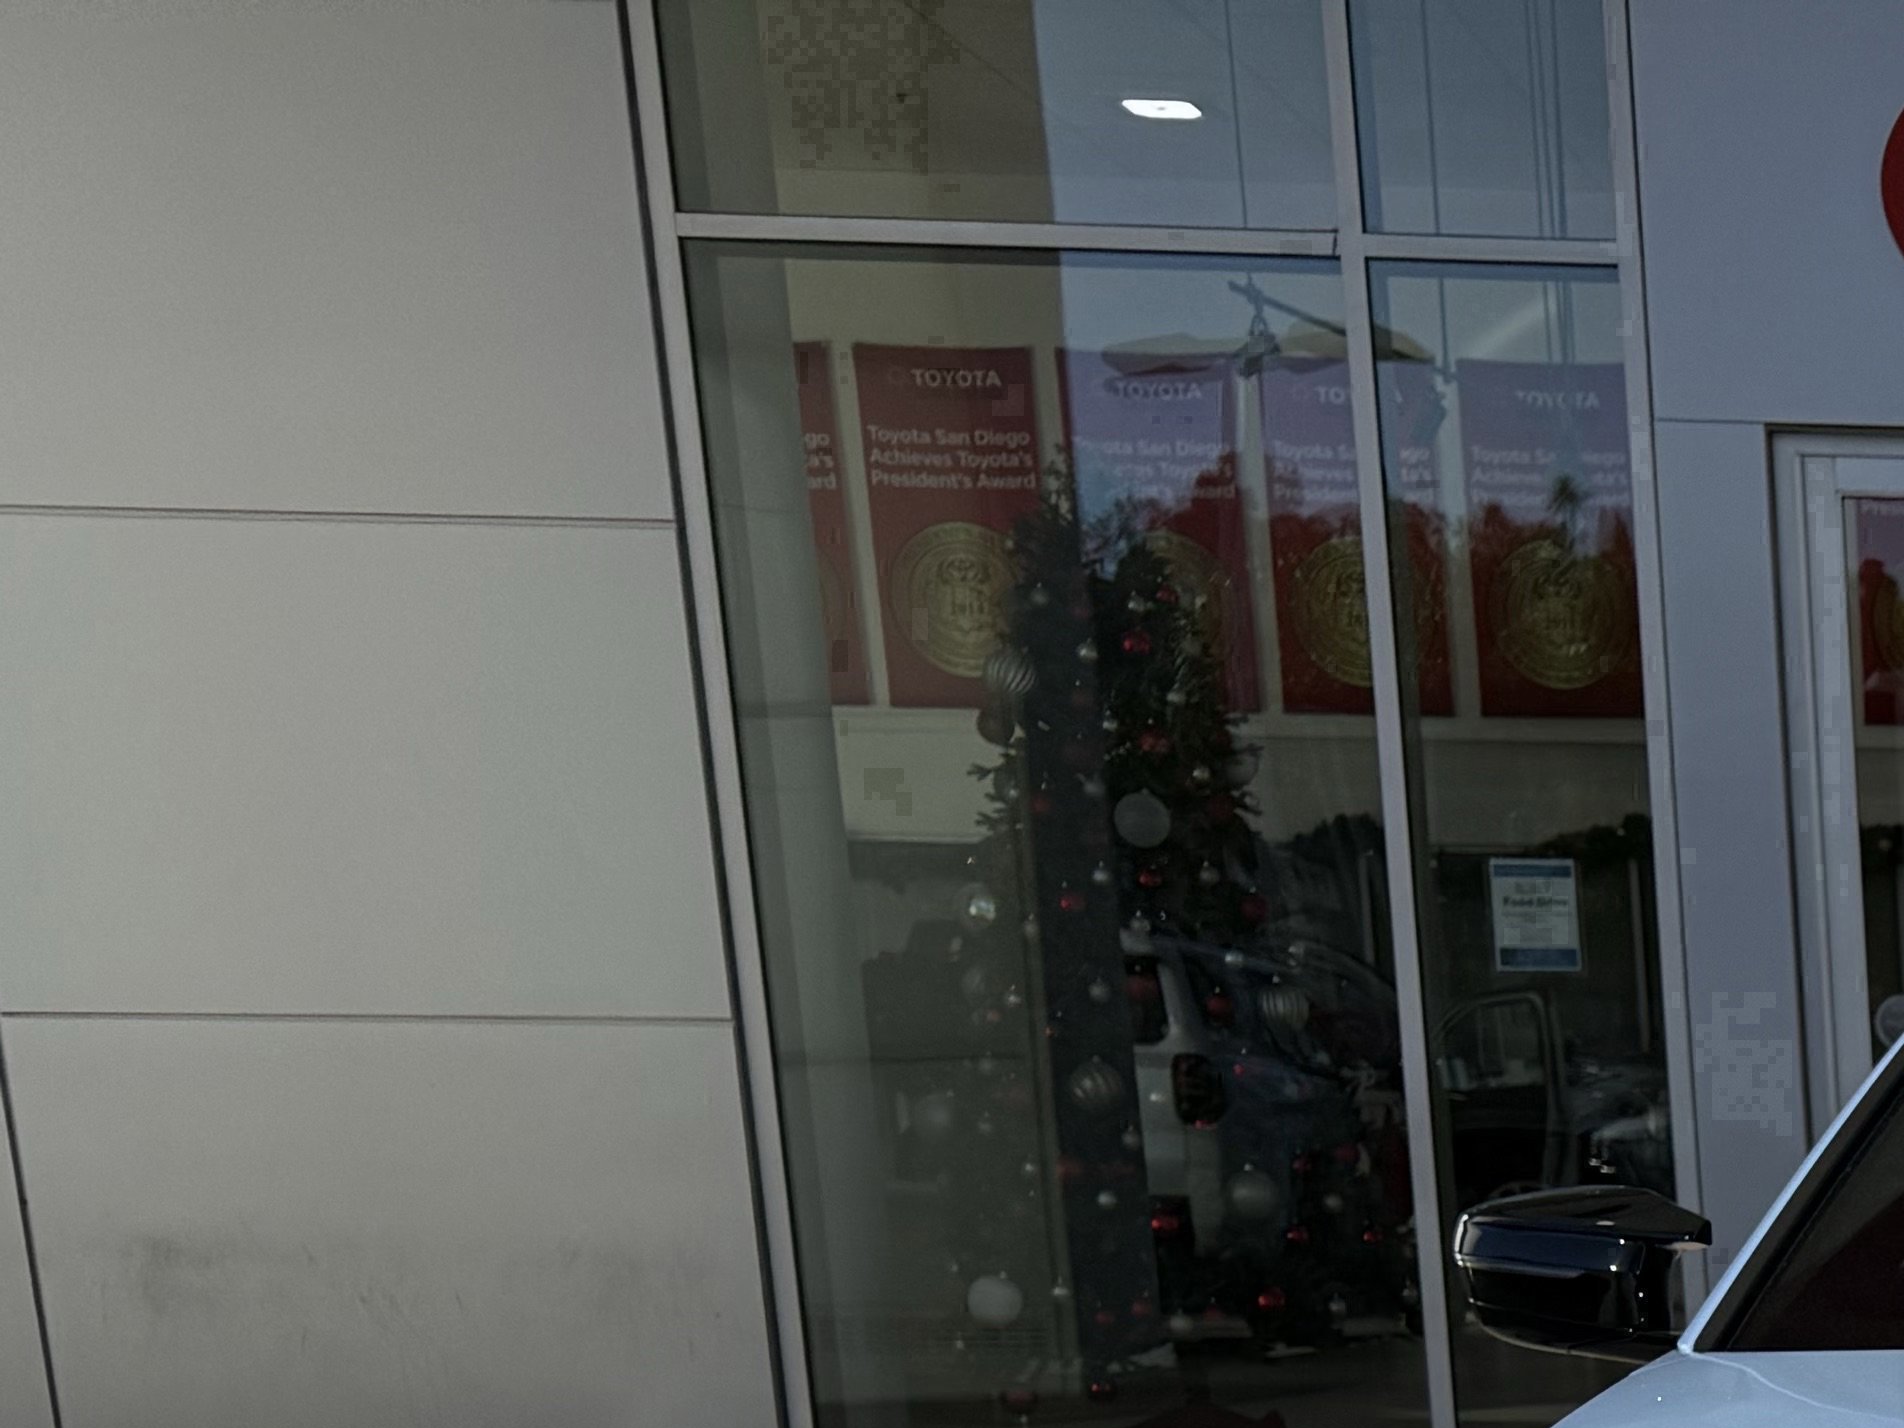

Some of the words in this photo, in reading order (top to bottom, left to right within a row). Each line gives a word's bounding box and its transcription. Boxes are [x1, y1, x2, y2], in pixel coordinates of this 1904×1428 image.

[910, 368, 1003, 388] TOYOTA
[1114, 381, 1203, 401] TOYOTA
[867, 425, 931, 446] Toyota
[935, 429, 970, 446] San
[974, 429, 1031, 448] Diego
[870, 450, 953, 467] Achieves
[959, 452, 1033, 471] Toyota's
[872, 470, 972, 489] President's
[976, 472, 1037, 490] Award
